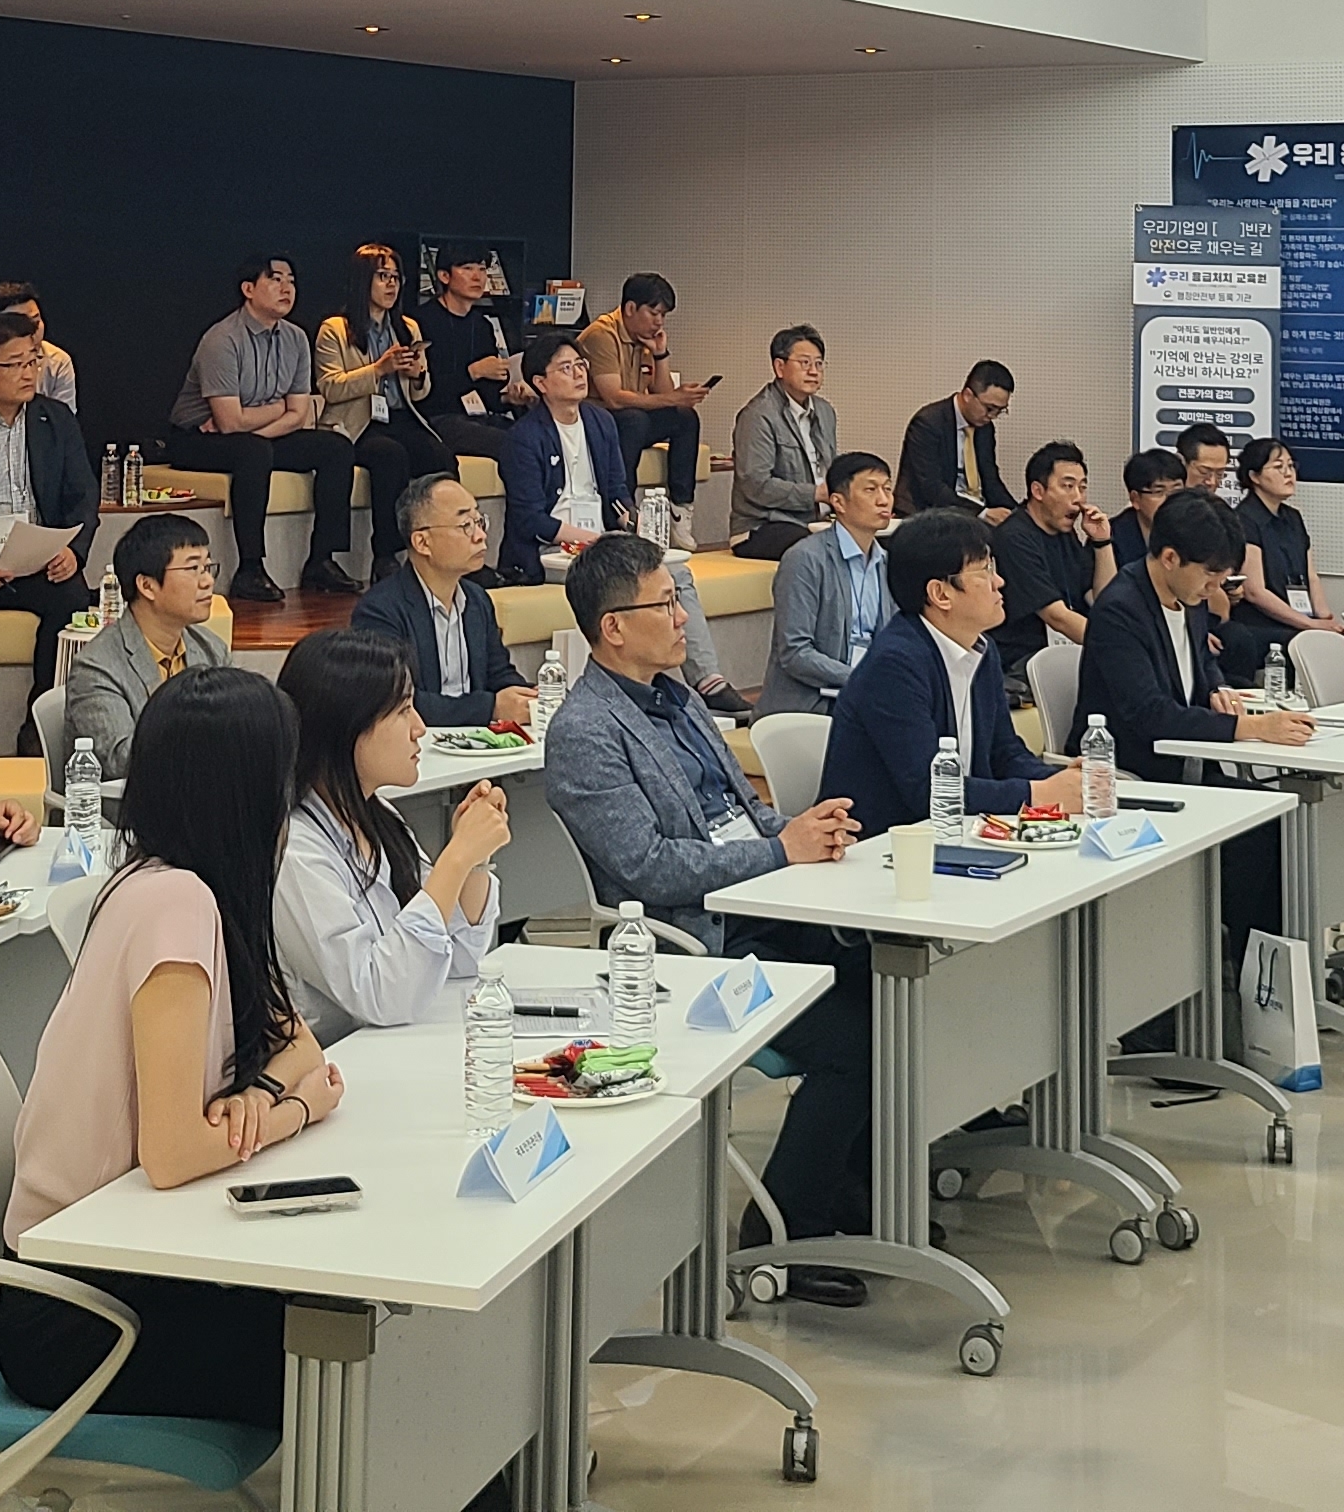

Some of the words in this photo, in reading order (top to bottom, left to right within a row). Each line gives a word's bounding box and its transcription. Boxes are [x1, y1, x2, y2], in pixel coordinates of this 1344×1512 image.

[1293, 143, 1335, 166] 우리
[1143, 220, 1208, 236] 우리기업의
[1150, 240, 1202, 254] 안전으로
[1207, 241, 1245, 255] 채우는
[1250, 242, 1263, 256] 길
[1168, 271, 1188, 282] 우리
[1192, 272, 1233, 283] 응급처치
[1237, 273, 1267, 284] 교육원
[1177, 292, 1216, 302] 행정안전부
[1218, 293, 1234, 302] 등록
[1236, 293, 1252, 303] 기관
[1172, 326, 1200, 334] "아직도
[1202, 326, 1241, 335] 일반인에게
[1163, 335, 1200, 344] 응급처치를
[1203, 336, 1250, 345] 배우시나요?"
[1150, 350, 1190, 363] "기억에
[1193, 351, 1227, 364] 안남는
[1229, 352, 1264, 365] 강의로
[1154, 365, 1198, 378] 시간낭비
[1201, 366, 1259, 379] 하시나요?"
[1178, 388, 1214, 399] 전문가의
[1215, 389, 1233, 400] 강의
[1177, 411, 1214, 422] 재미있는
[1215, 412, 1233, 423] 강의
